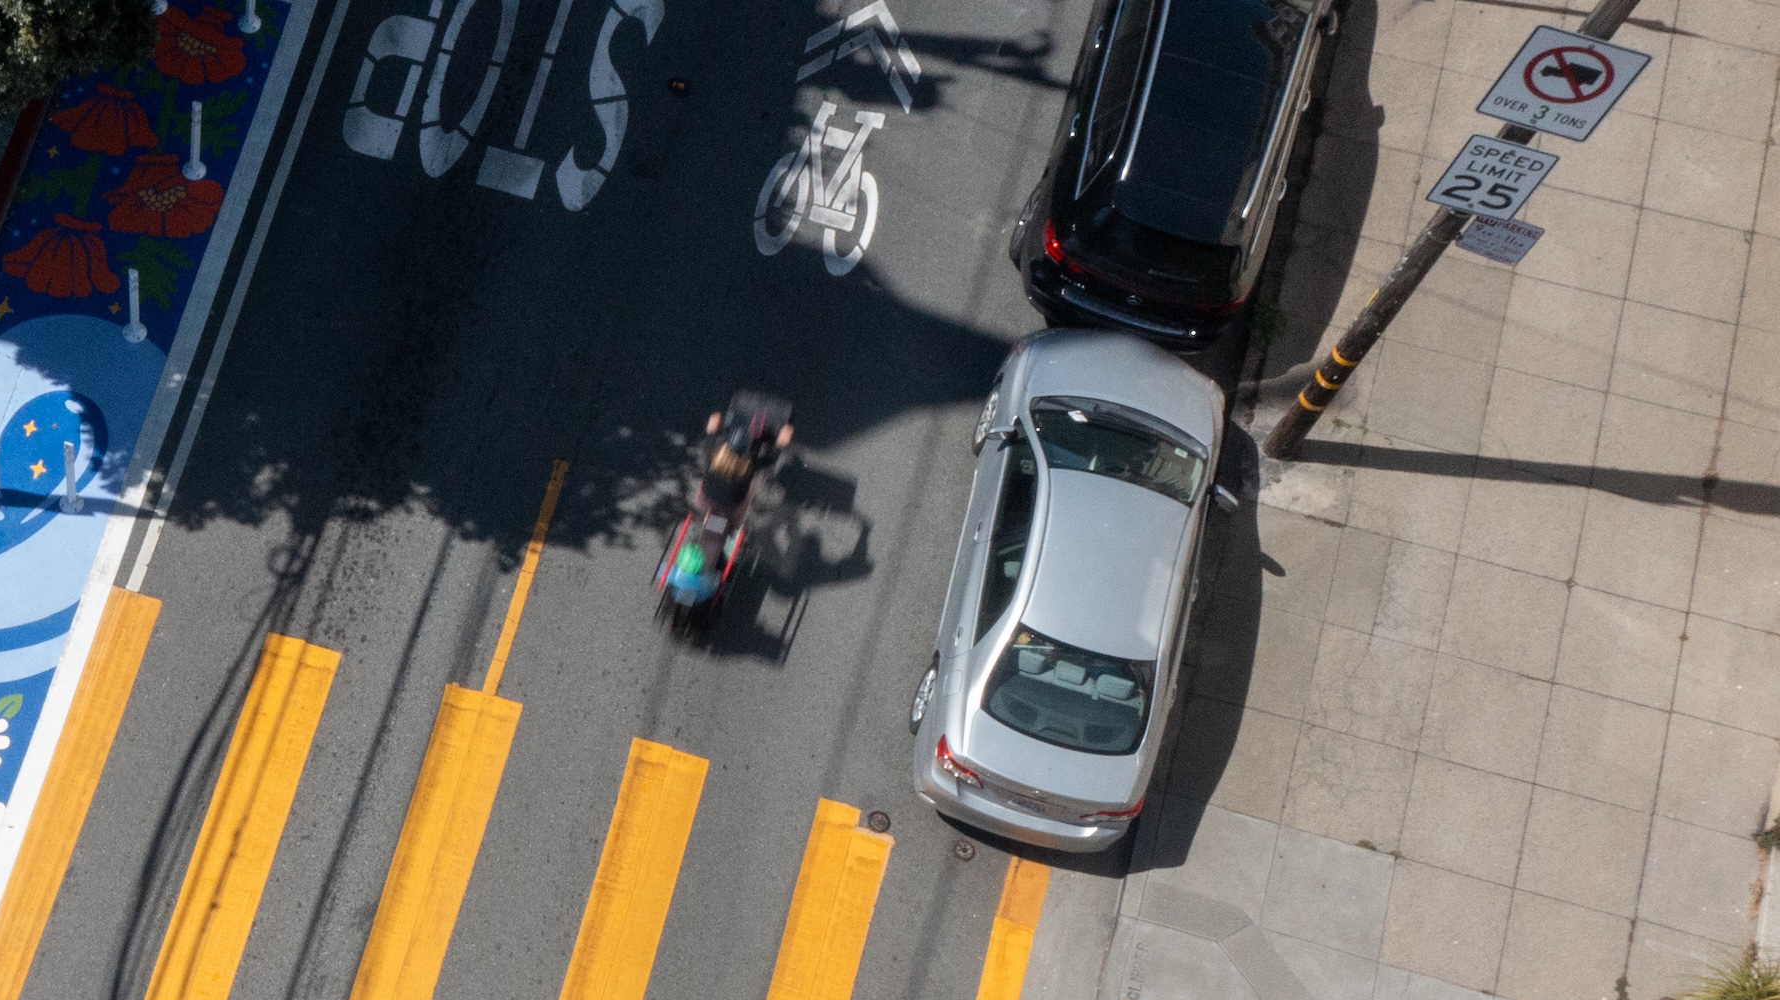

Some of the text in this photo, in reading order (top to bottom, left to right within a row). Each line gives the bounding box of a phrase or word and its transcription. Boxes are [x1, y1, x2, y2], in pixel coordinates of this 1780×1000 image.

[1494, 95, 1587, 129] OVER 3 TONS
[1466, 160, 1526, 183] LIMIT
[1469, 144, 1544, 171] SPEED
[1441, 174, 1518, 209] 25
